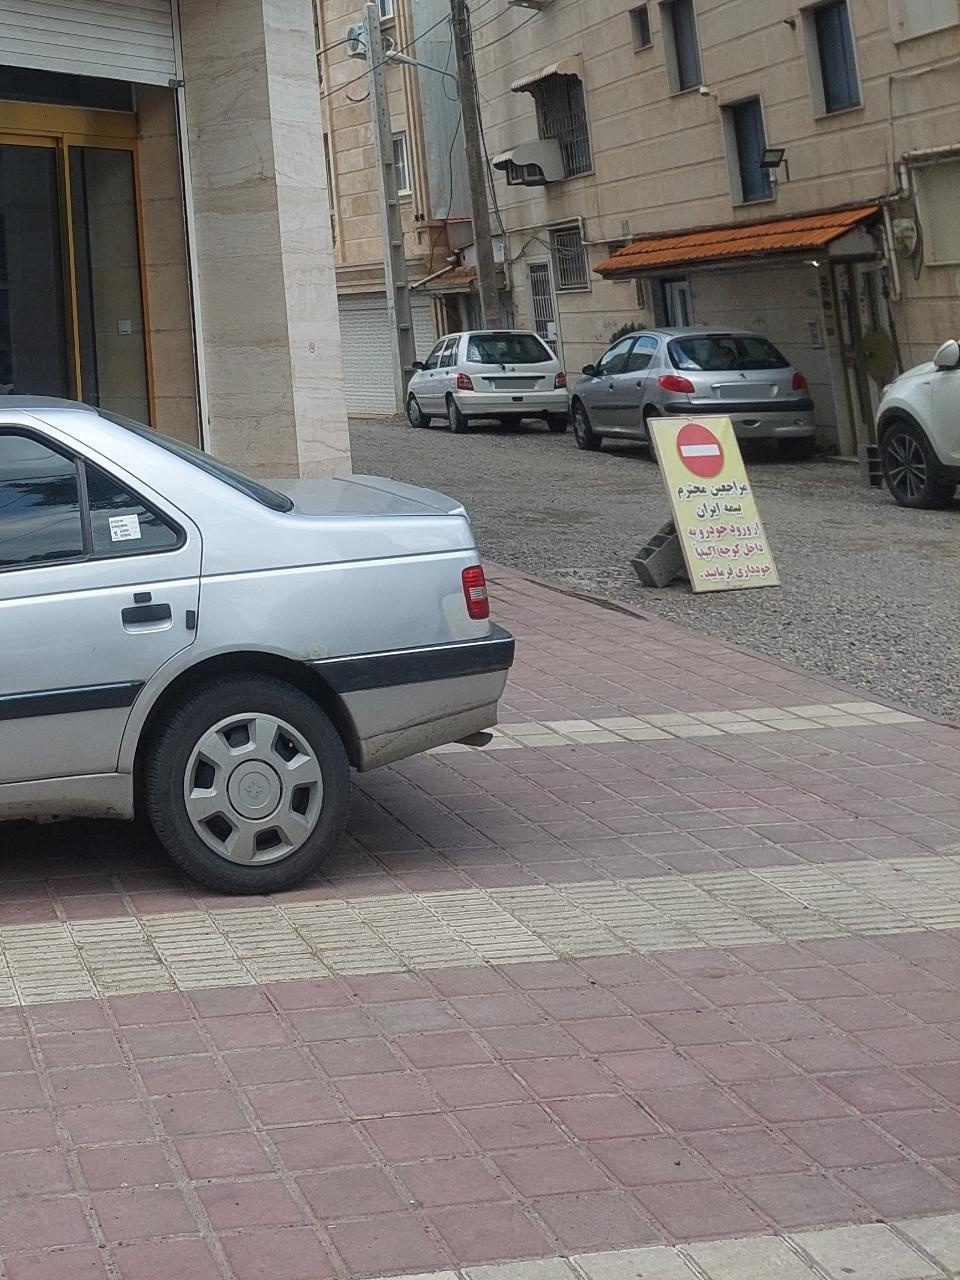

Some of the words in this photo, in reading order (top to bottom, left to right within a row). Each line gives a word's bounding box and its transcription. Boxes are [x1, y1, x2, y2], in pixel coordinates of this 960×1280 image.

[677, 483, 707, 499] محترم
[711, 481, 748, 497] مراجعین
[696, 502, 720, 519] ایران
[724, 503, 743, 516] بیمه
[730, 524, 751, 537] ورود
[743, 542, 763, 557] داخل
[735, 562, 771, 579] خودداری
